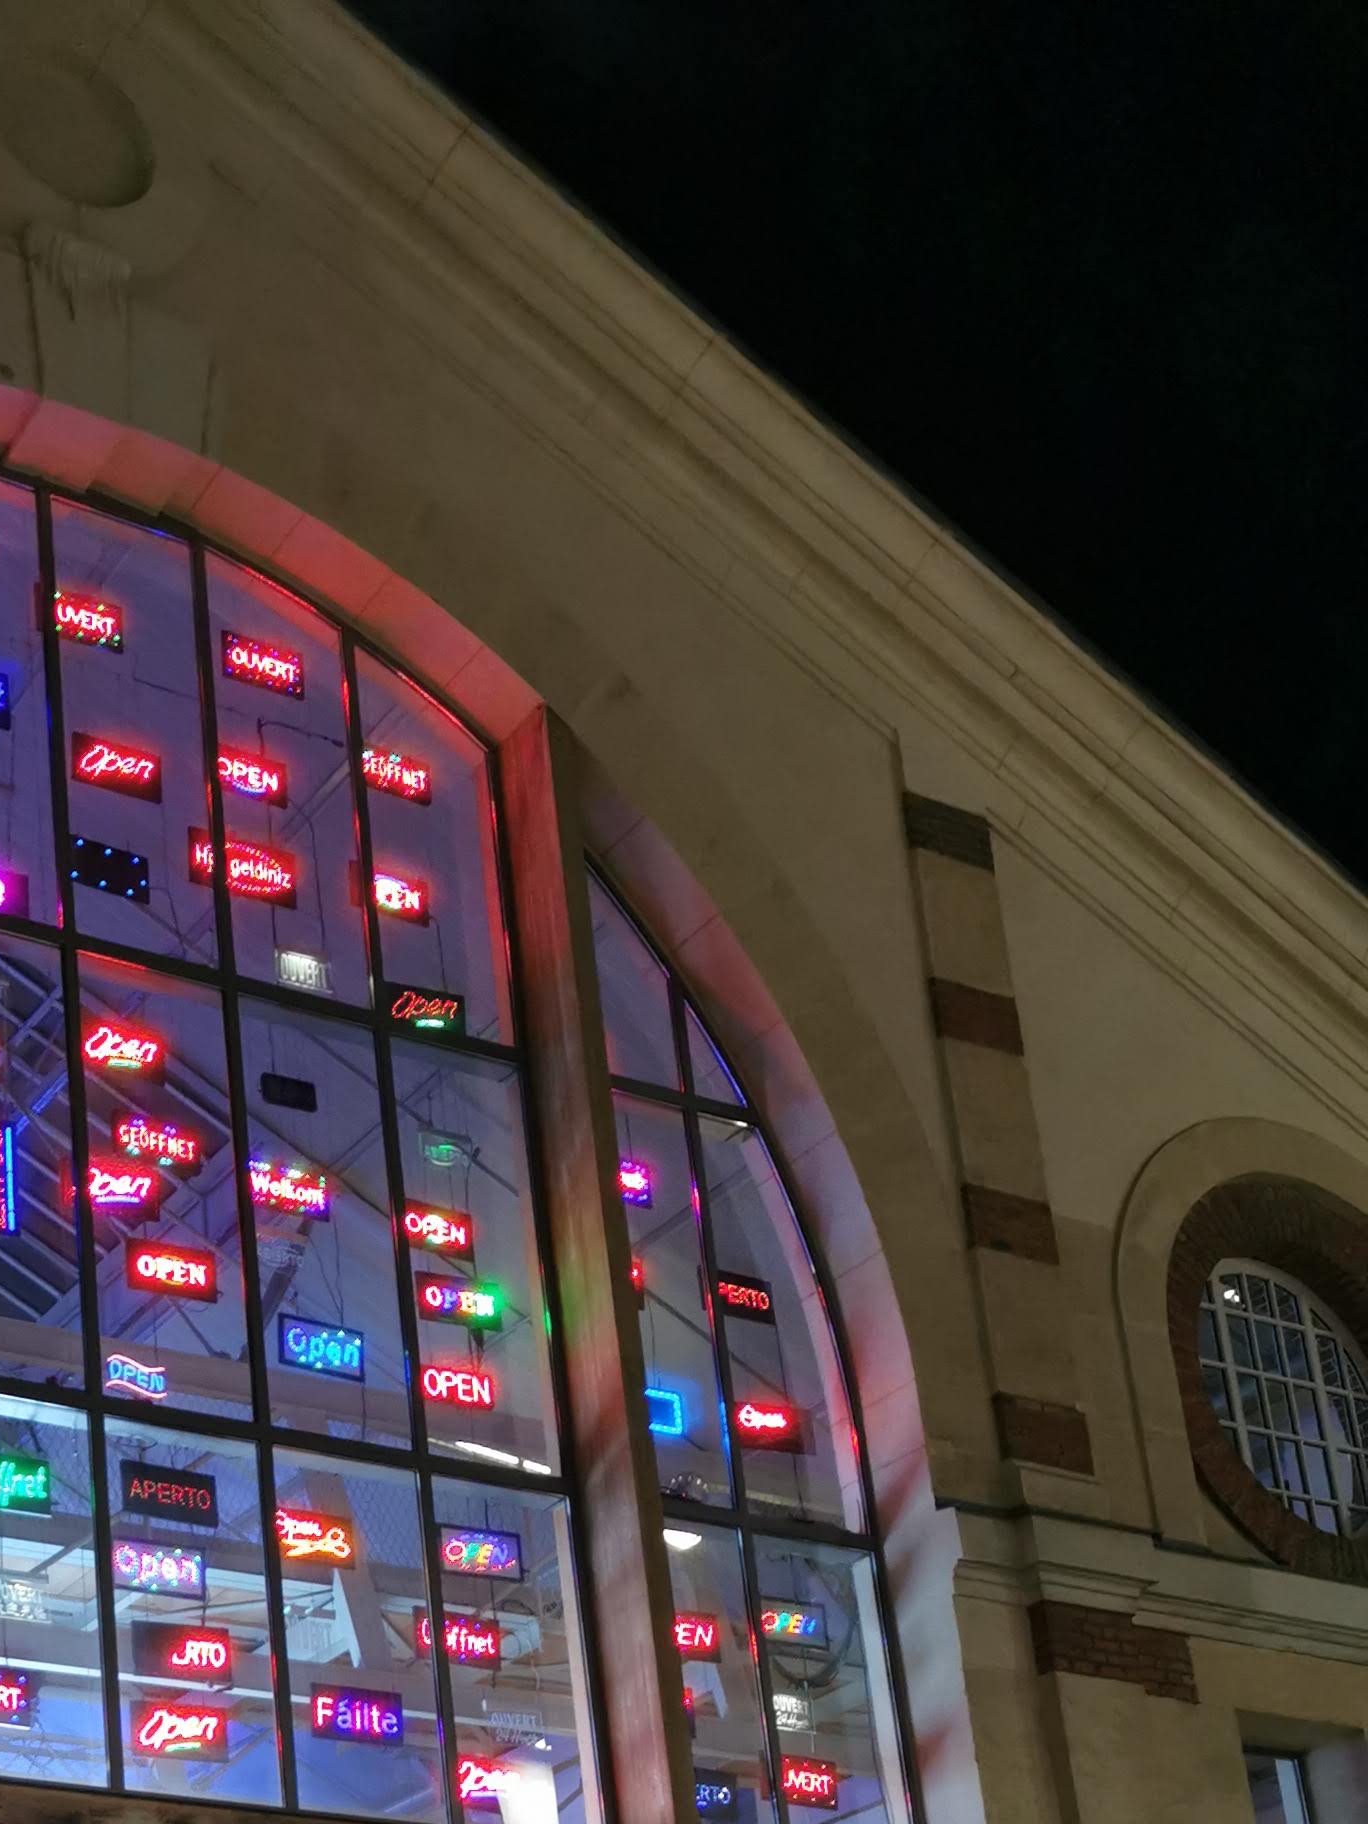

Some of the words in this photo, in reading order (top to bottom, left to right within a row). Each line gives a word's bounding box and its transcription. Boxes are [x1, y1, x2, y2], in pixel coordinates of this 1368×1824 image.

[56, 603, 115, 637] UVERT
[231, 647, 294, 683] OUVERT
[80, 745, 153, 779] Open
[392, 990, 459, 1020] Open
[85, 1026, 157, 1062] Open
[405, 1213, 465, 1244] OPEN
[137, 1254, 206, 1285] OPEN
[426, 1285, 495, 1317] OPEN
[287, 1327, 360, 1368] Open
[108, 1359, 165, 1391] OPEN
[424, 1369, 490, 1403] OPEN
[130, 1478, 211, 1509] APERTO
[114, 1545, 199, 1585] Open
[444, 1539, 508, 1564] OPEN
[761, 1611, 816, 1635] OPEN
[139, 1710, 217, 1747] Open
[784, 1770, 831, 1795] UVERT
